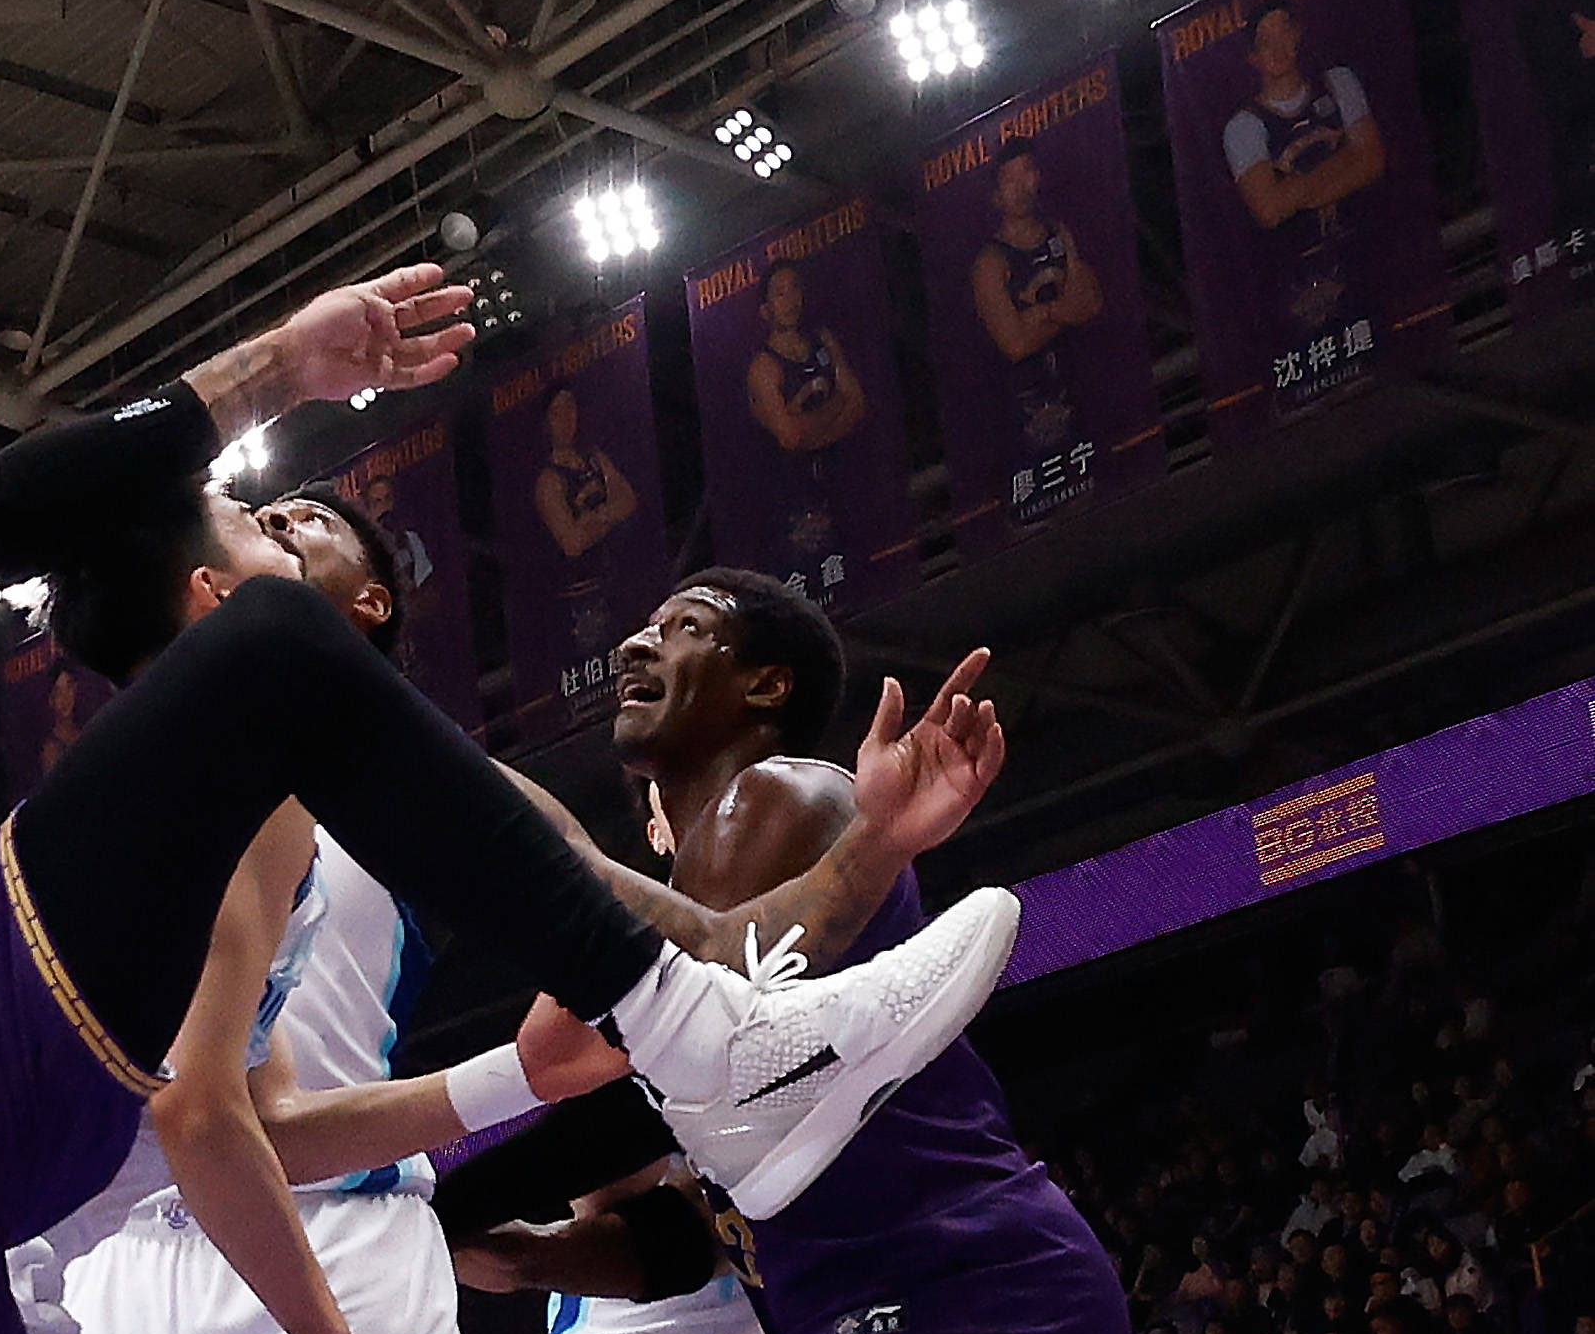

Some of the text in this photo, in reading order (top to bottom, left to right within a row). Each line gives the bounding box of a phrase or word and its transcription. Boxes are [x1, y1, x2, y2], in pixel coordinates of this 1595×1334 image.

[922, 66, 1110, 193] ROYAL FIGHTERS
[697, 196, 870, 310] ROYAL FIGHTERS
